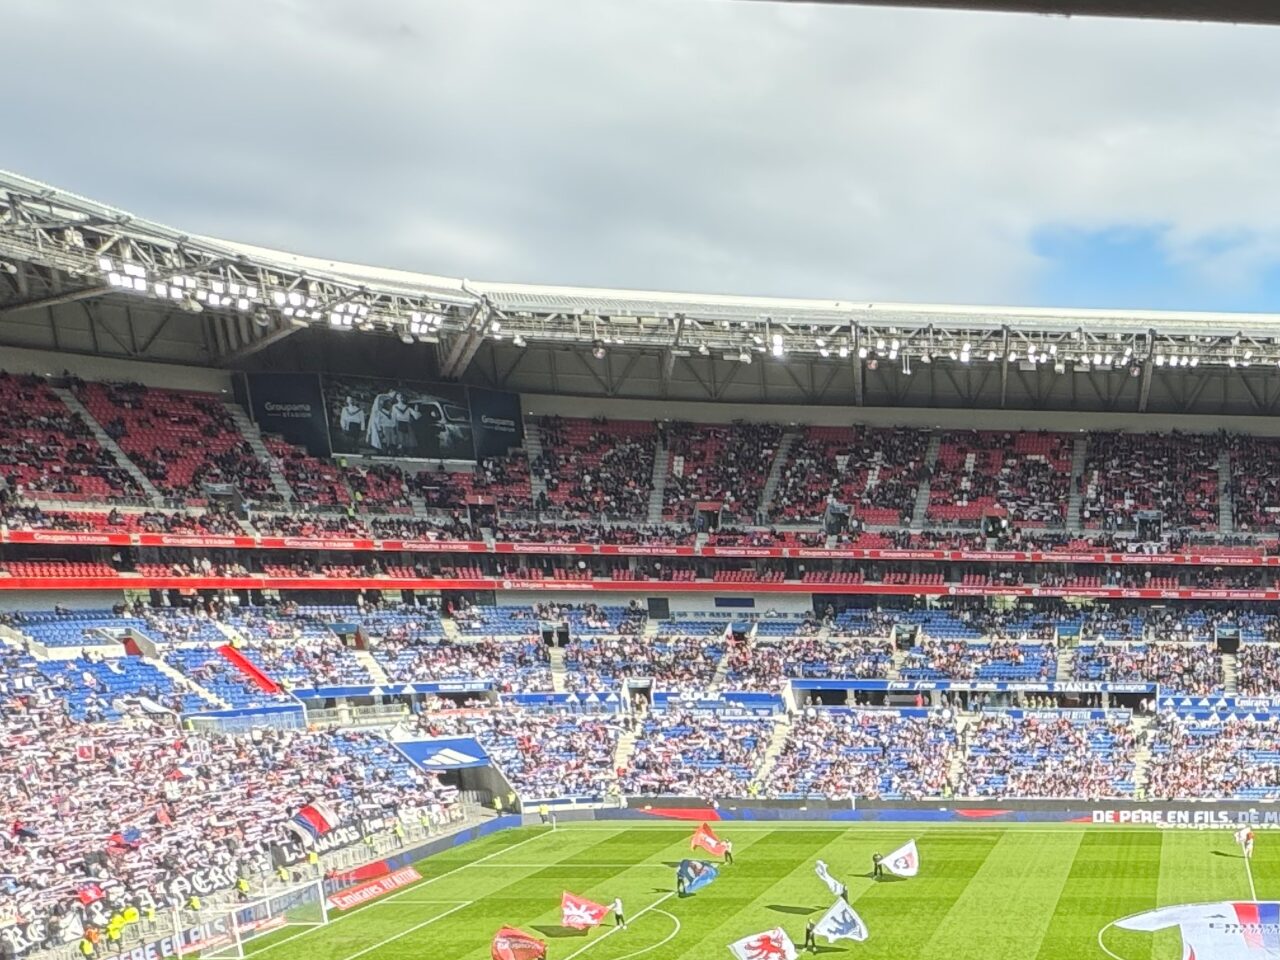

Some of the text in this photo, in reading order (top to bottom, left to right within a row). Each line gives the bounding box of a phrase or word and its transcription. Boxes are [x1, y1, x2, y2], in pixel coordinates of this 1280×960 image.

[264, 402, 311, 412] Groupama
[1053, 682, 1102, 692] STANLEY
[1093, 810, 1114, 823] DE
[1167, 811, 1189, 823] EN
[1238, 811, 1260, 823] DE
[1155, 822, 1247, 831] Groupama
[335, 882, 384, 908] Emirates
